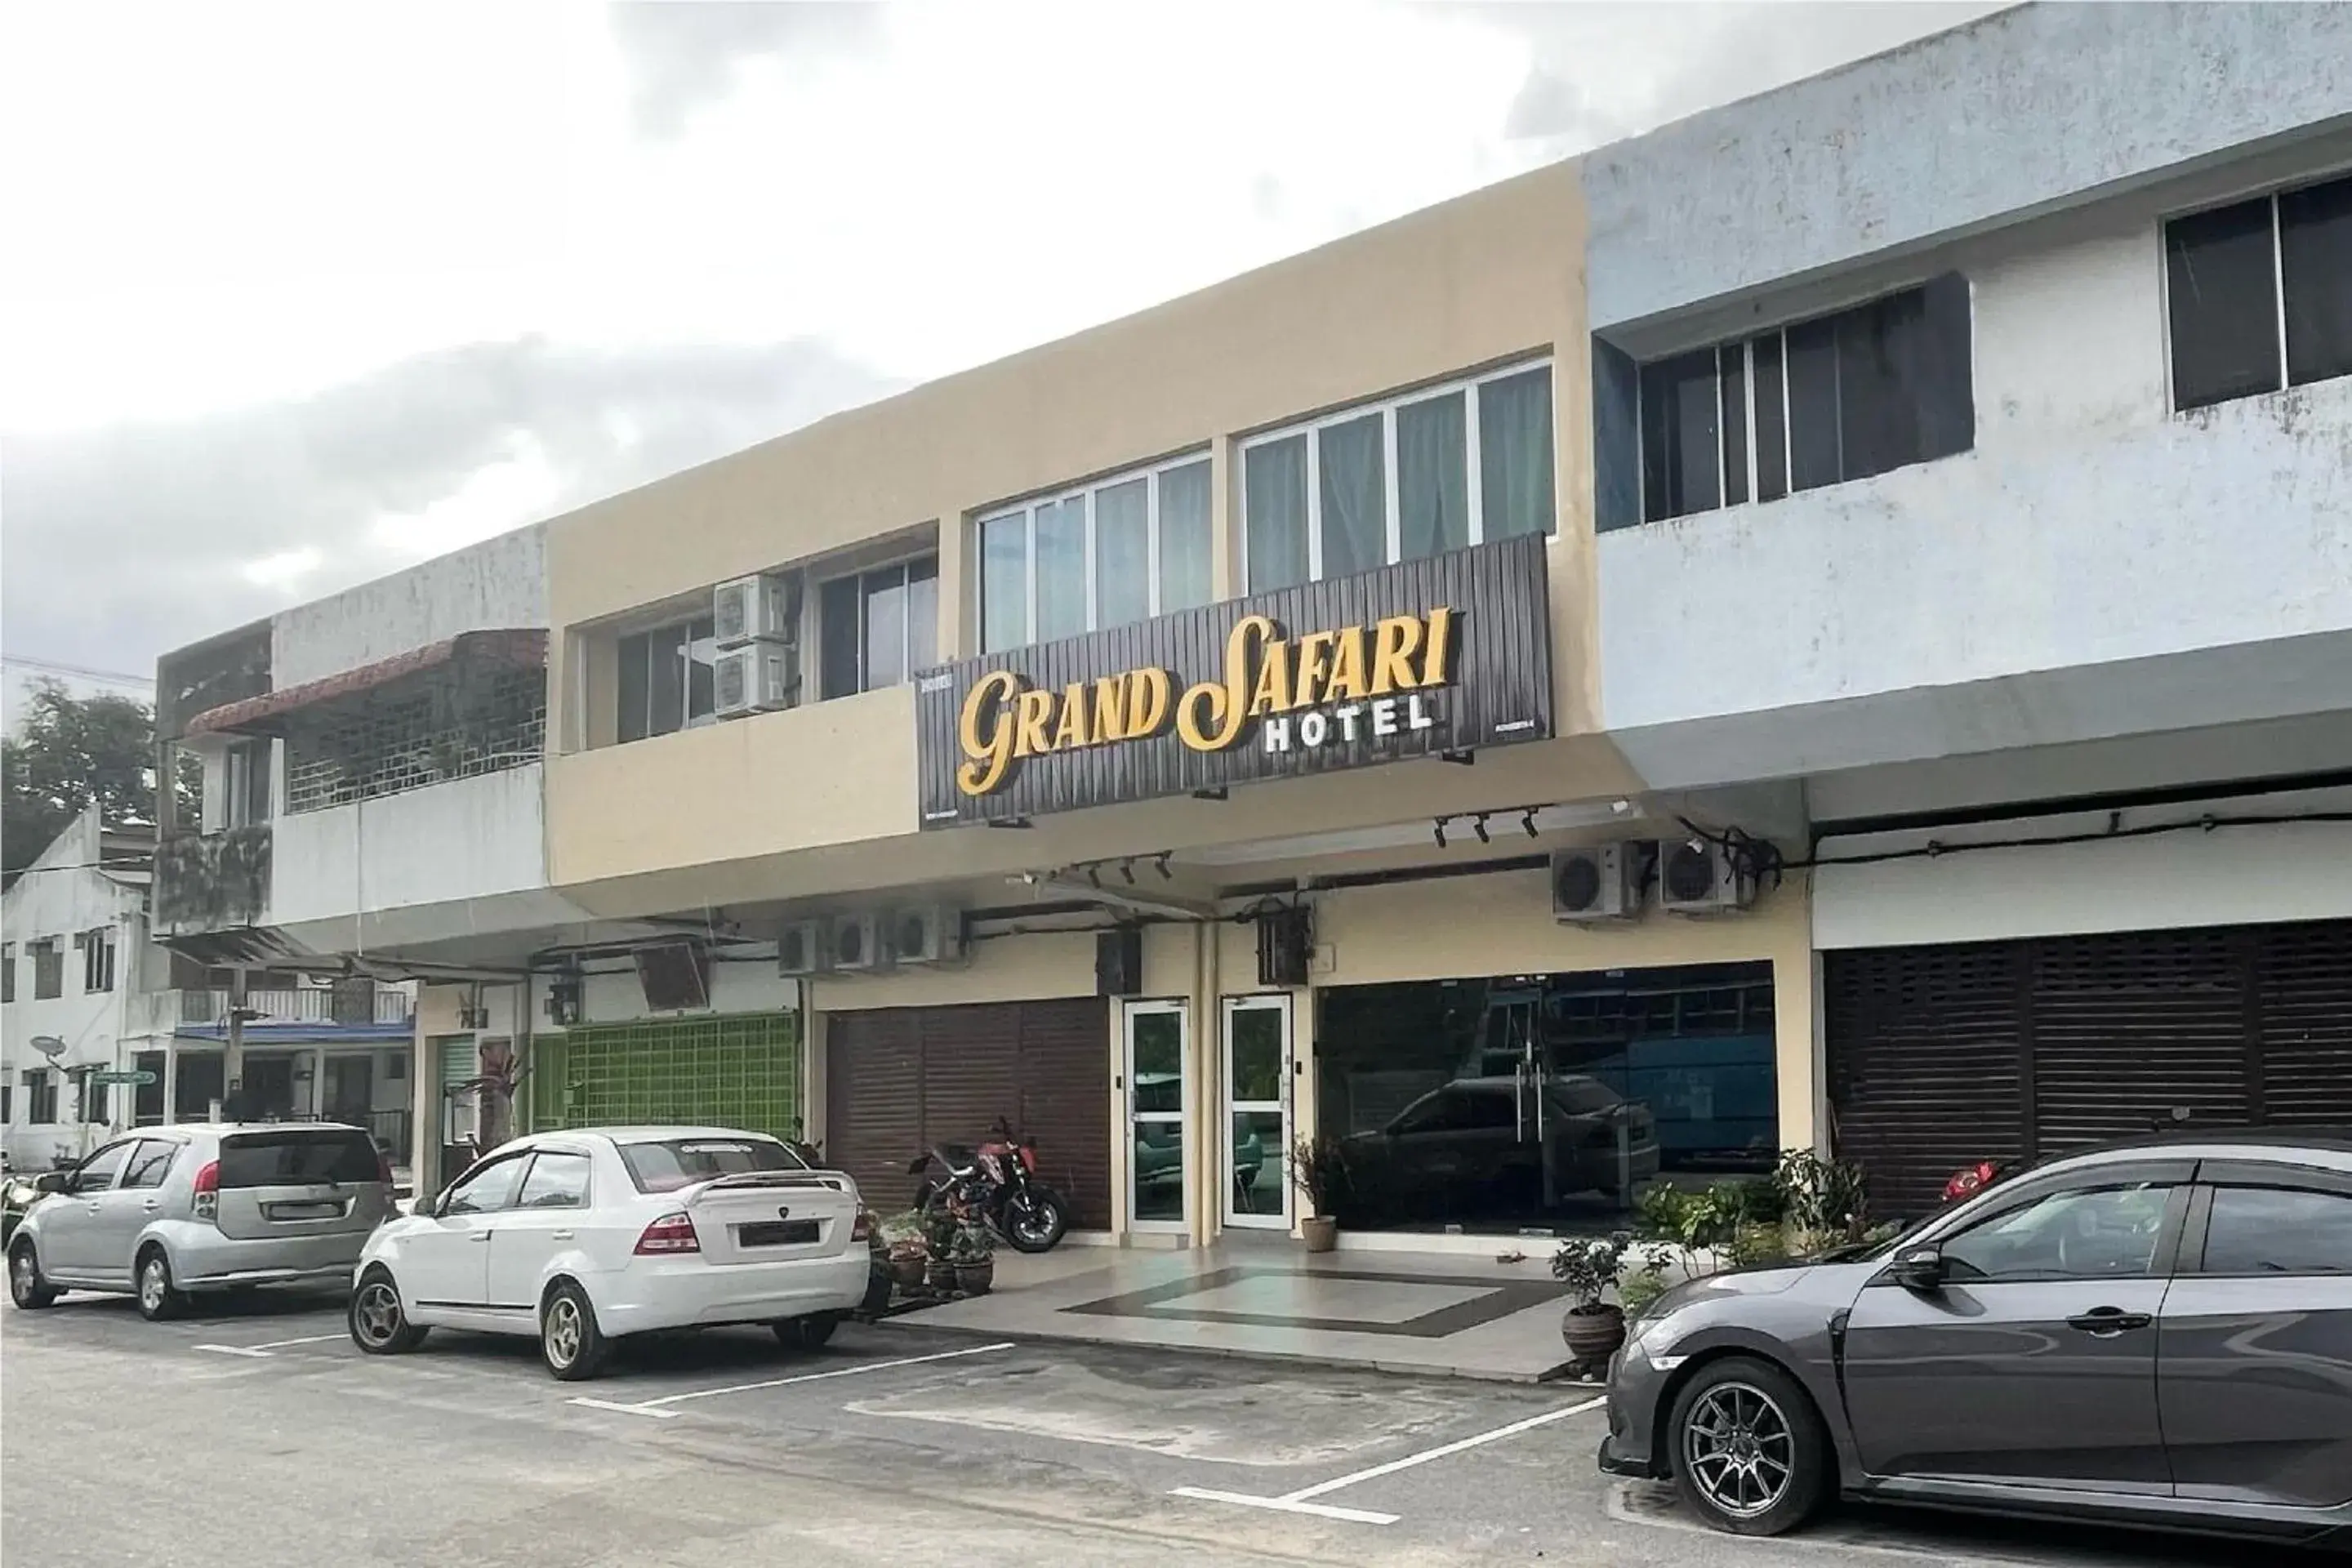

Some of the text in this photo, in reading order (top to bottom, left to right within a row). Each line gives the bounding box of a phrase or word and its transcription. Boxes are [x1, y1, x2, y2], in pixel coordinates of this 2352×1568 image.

[957, 606, 1451, 795] GRAND SAFARI
[1266, 694, 1432, 753] HOTEL
